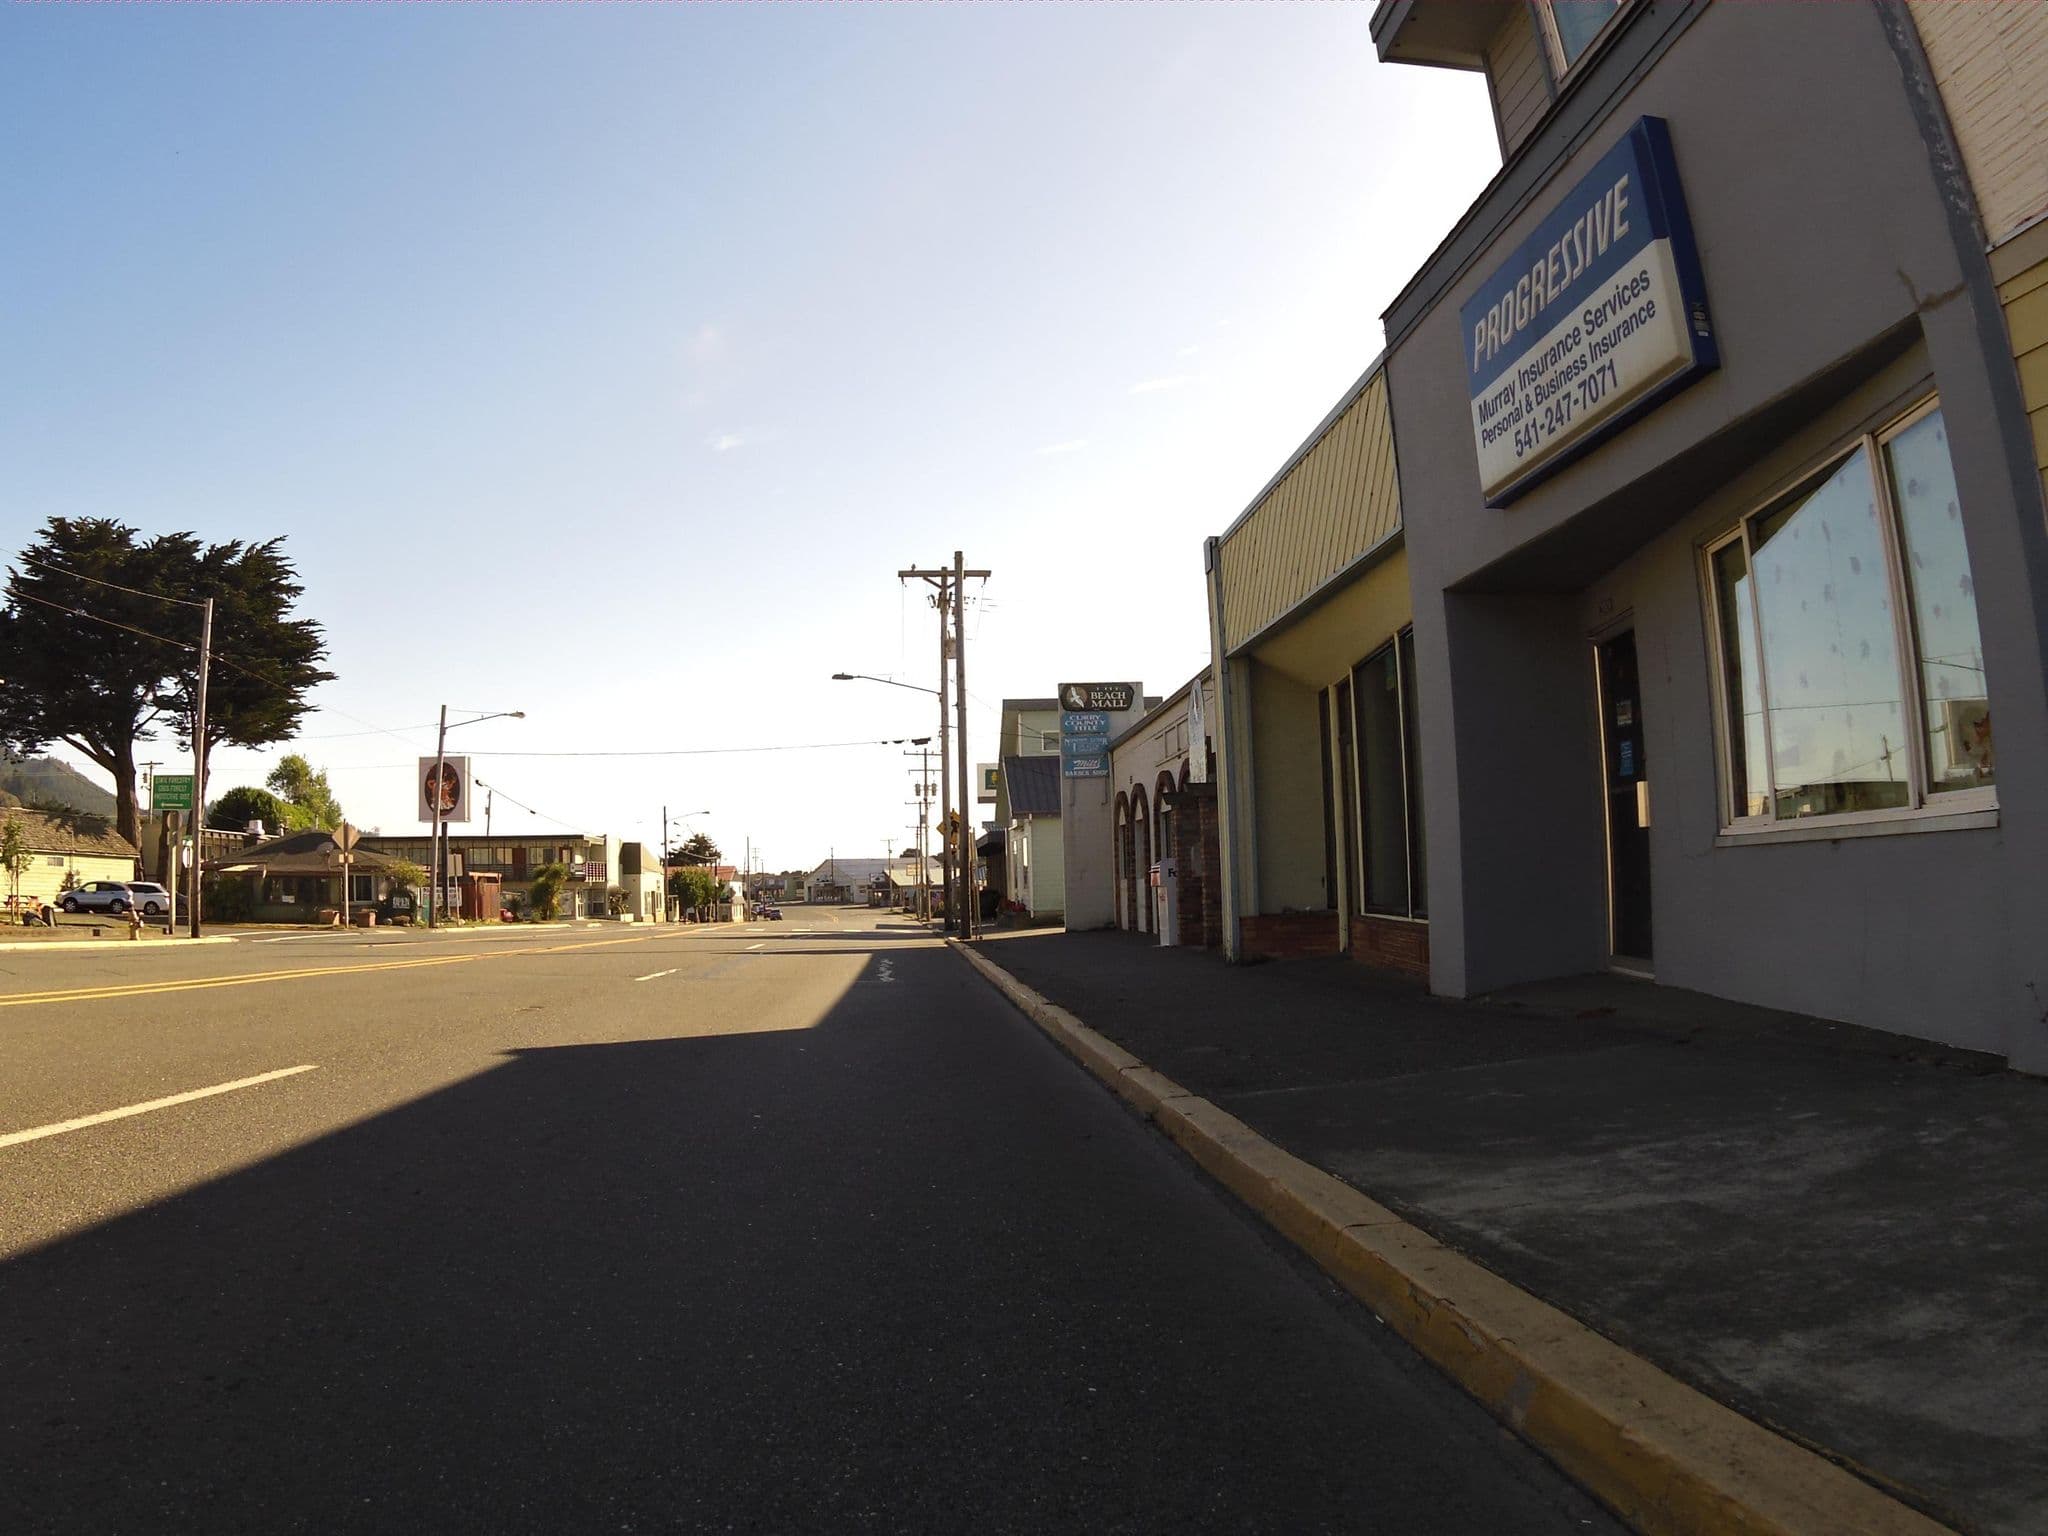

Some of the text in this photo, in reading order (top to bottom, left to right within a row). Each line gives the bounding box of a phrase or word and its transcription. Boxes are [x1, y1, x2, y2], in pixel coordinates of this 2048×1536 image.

[1474, 173, 1629, 373] PROGRESSIVE
[1478, 378, 1516, 426] Murray
[1518, 325, 1581, 391] Insurance
[1583, 269, 1650, 336] Services
[1481, 405, 1523, 448] Personal
[1525, 393, 1534, 414] &
[1535, 353, 1588, 405] Business
[1589, 299, 1656, 364] Insurance
[1514, 358, 1618, 457] 541-247-7071
[1090, 691, 1126, 699] BEACH
[1091, 700, 1127, 708] MALL
